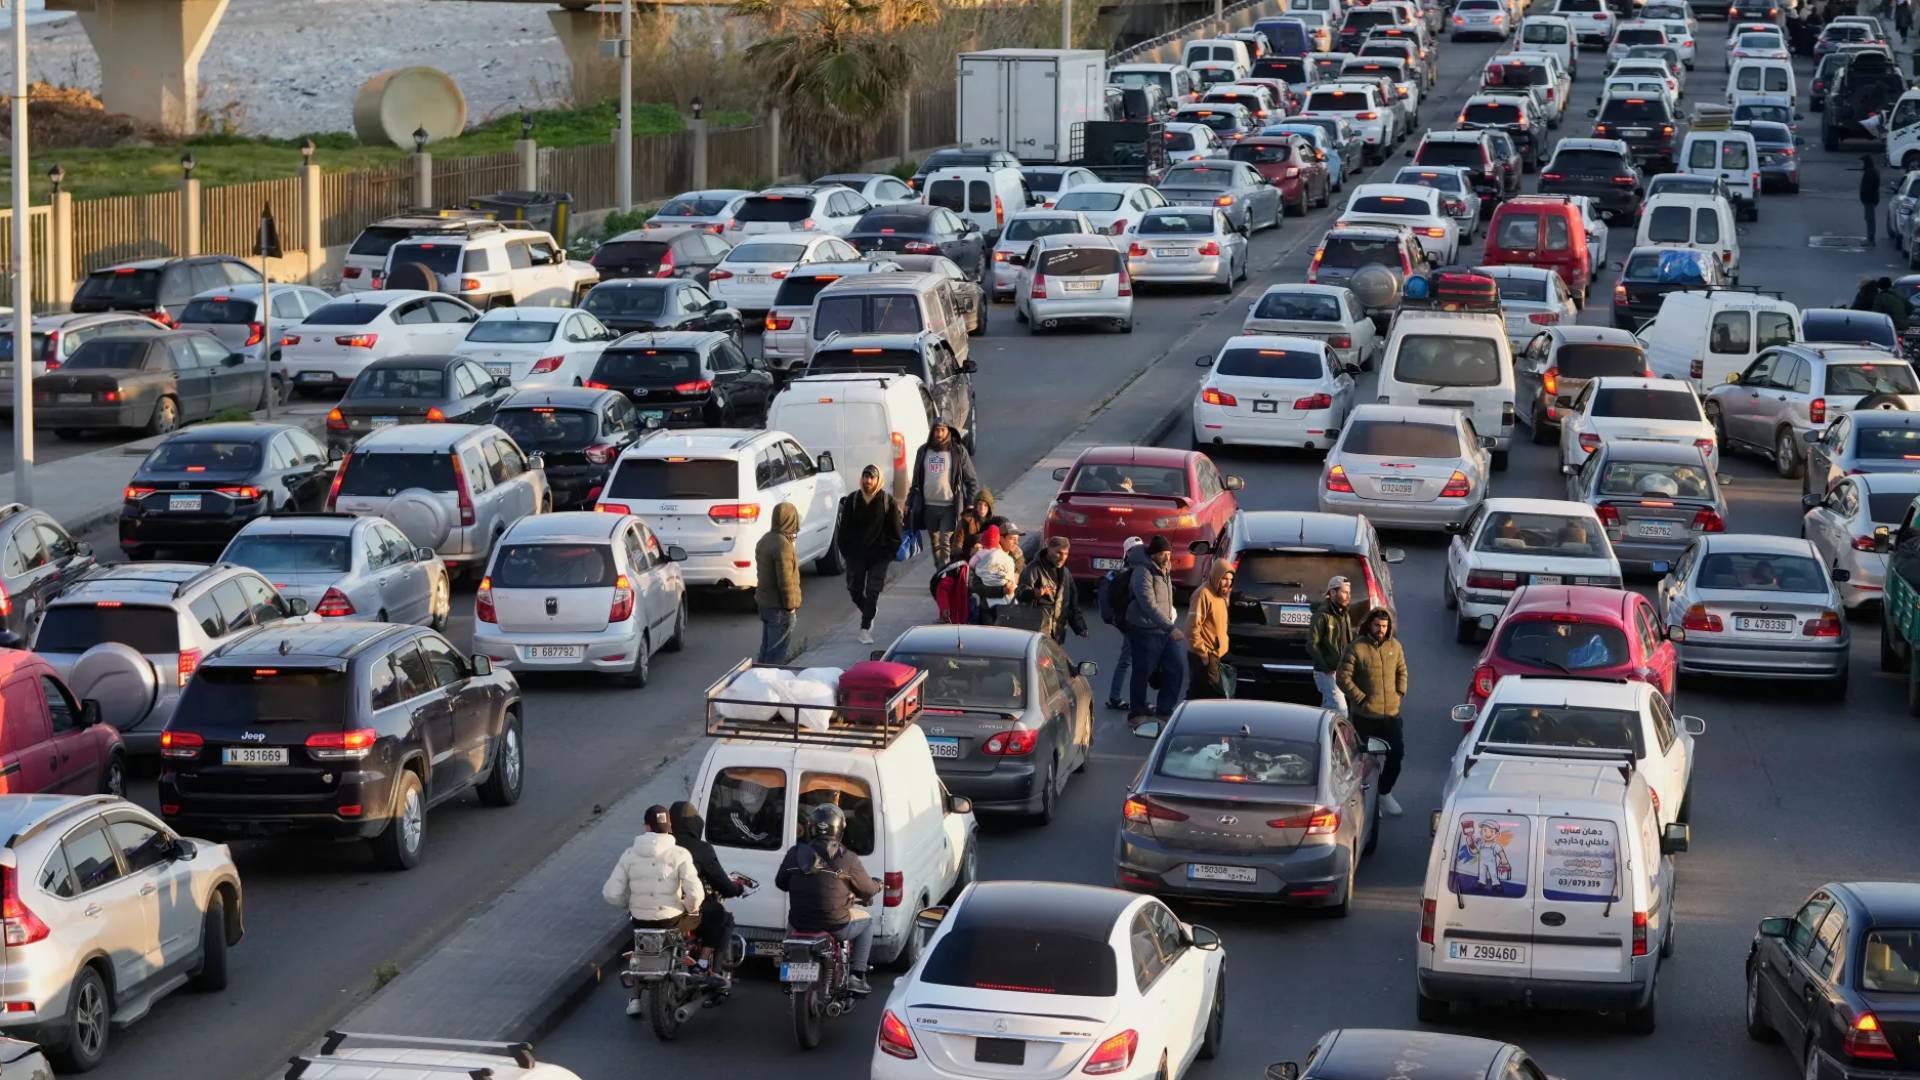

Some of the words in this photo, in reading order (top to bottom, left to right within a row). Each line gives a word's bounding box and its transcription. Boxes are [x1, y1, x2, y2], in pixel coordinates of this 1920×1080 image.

[1755, 619, 1787, 630] 478338
[531, 647, 537, 657] B
[542, 647, 574, 657] 687792
[241, 731, 266, 743] Jeep
[231, 750, 238, 761] N
[243, 750, 281, 761] 391669
[1459, 945, 1468, 958] M
[1473, 945, 1517, 961] 299460
